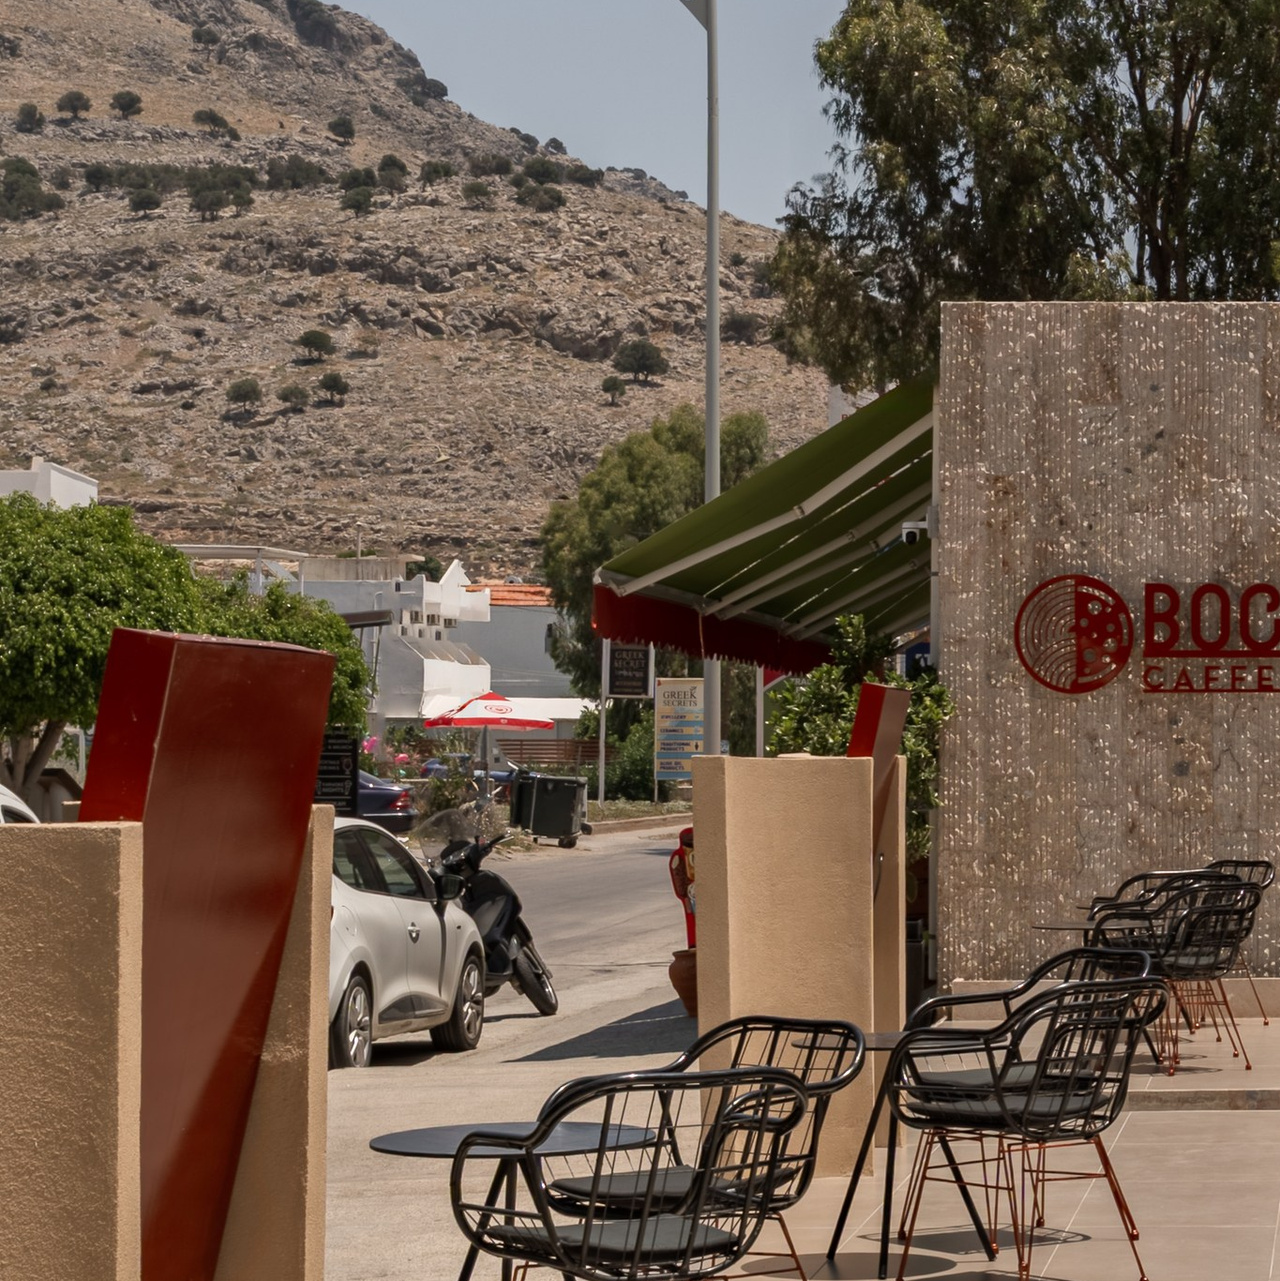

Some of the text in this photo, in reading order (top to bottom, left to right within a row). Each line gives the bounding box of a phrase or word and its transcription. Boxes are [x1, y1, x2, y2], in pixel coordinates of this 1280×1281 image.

[615, 651, 645, 659] GREEK
[1143, 665, 1274, 691] CAFFE
[662, 690, 697, 700] GREEK
[662, 699, 698, 707] SECRETS
